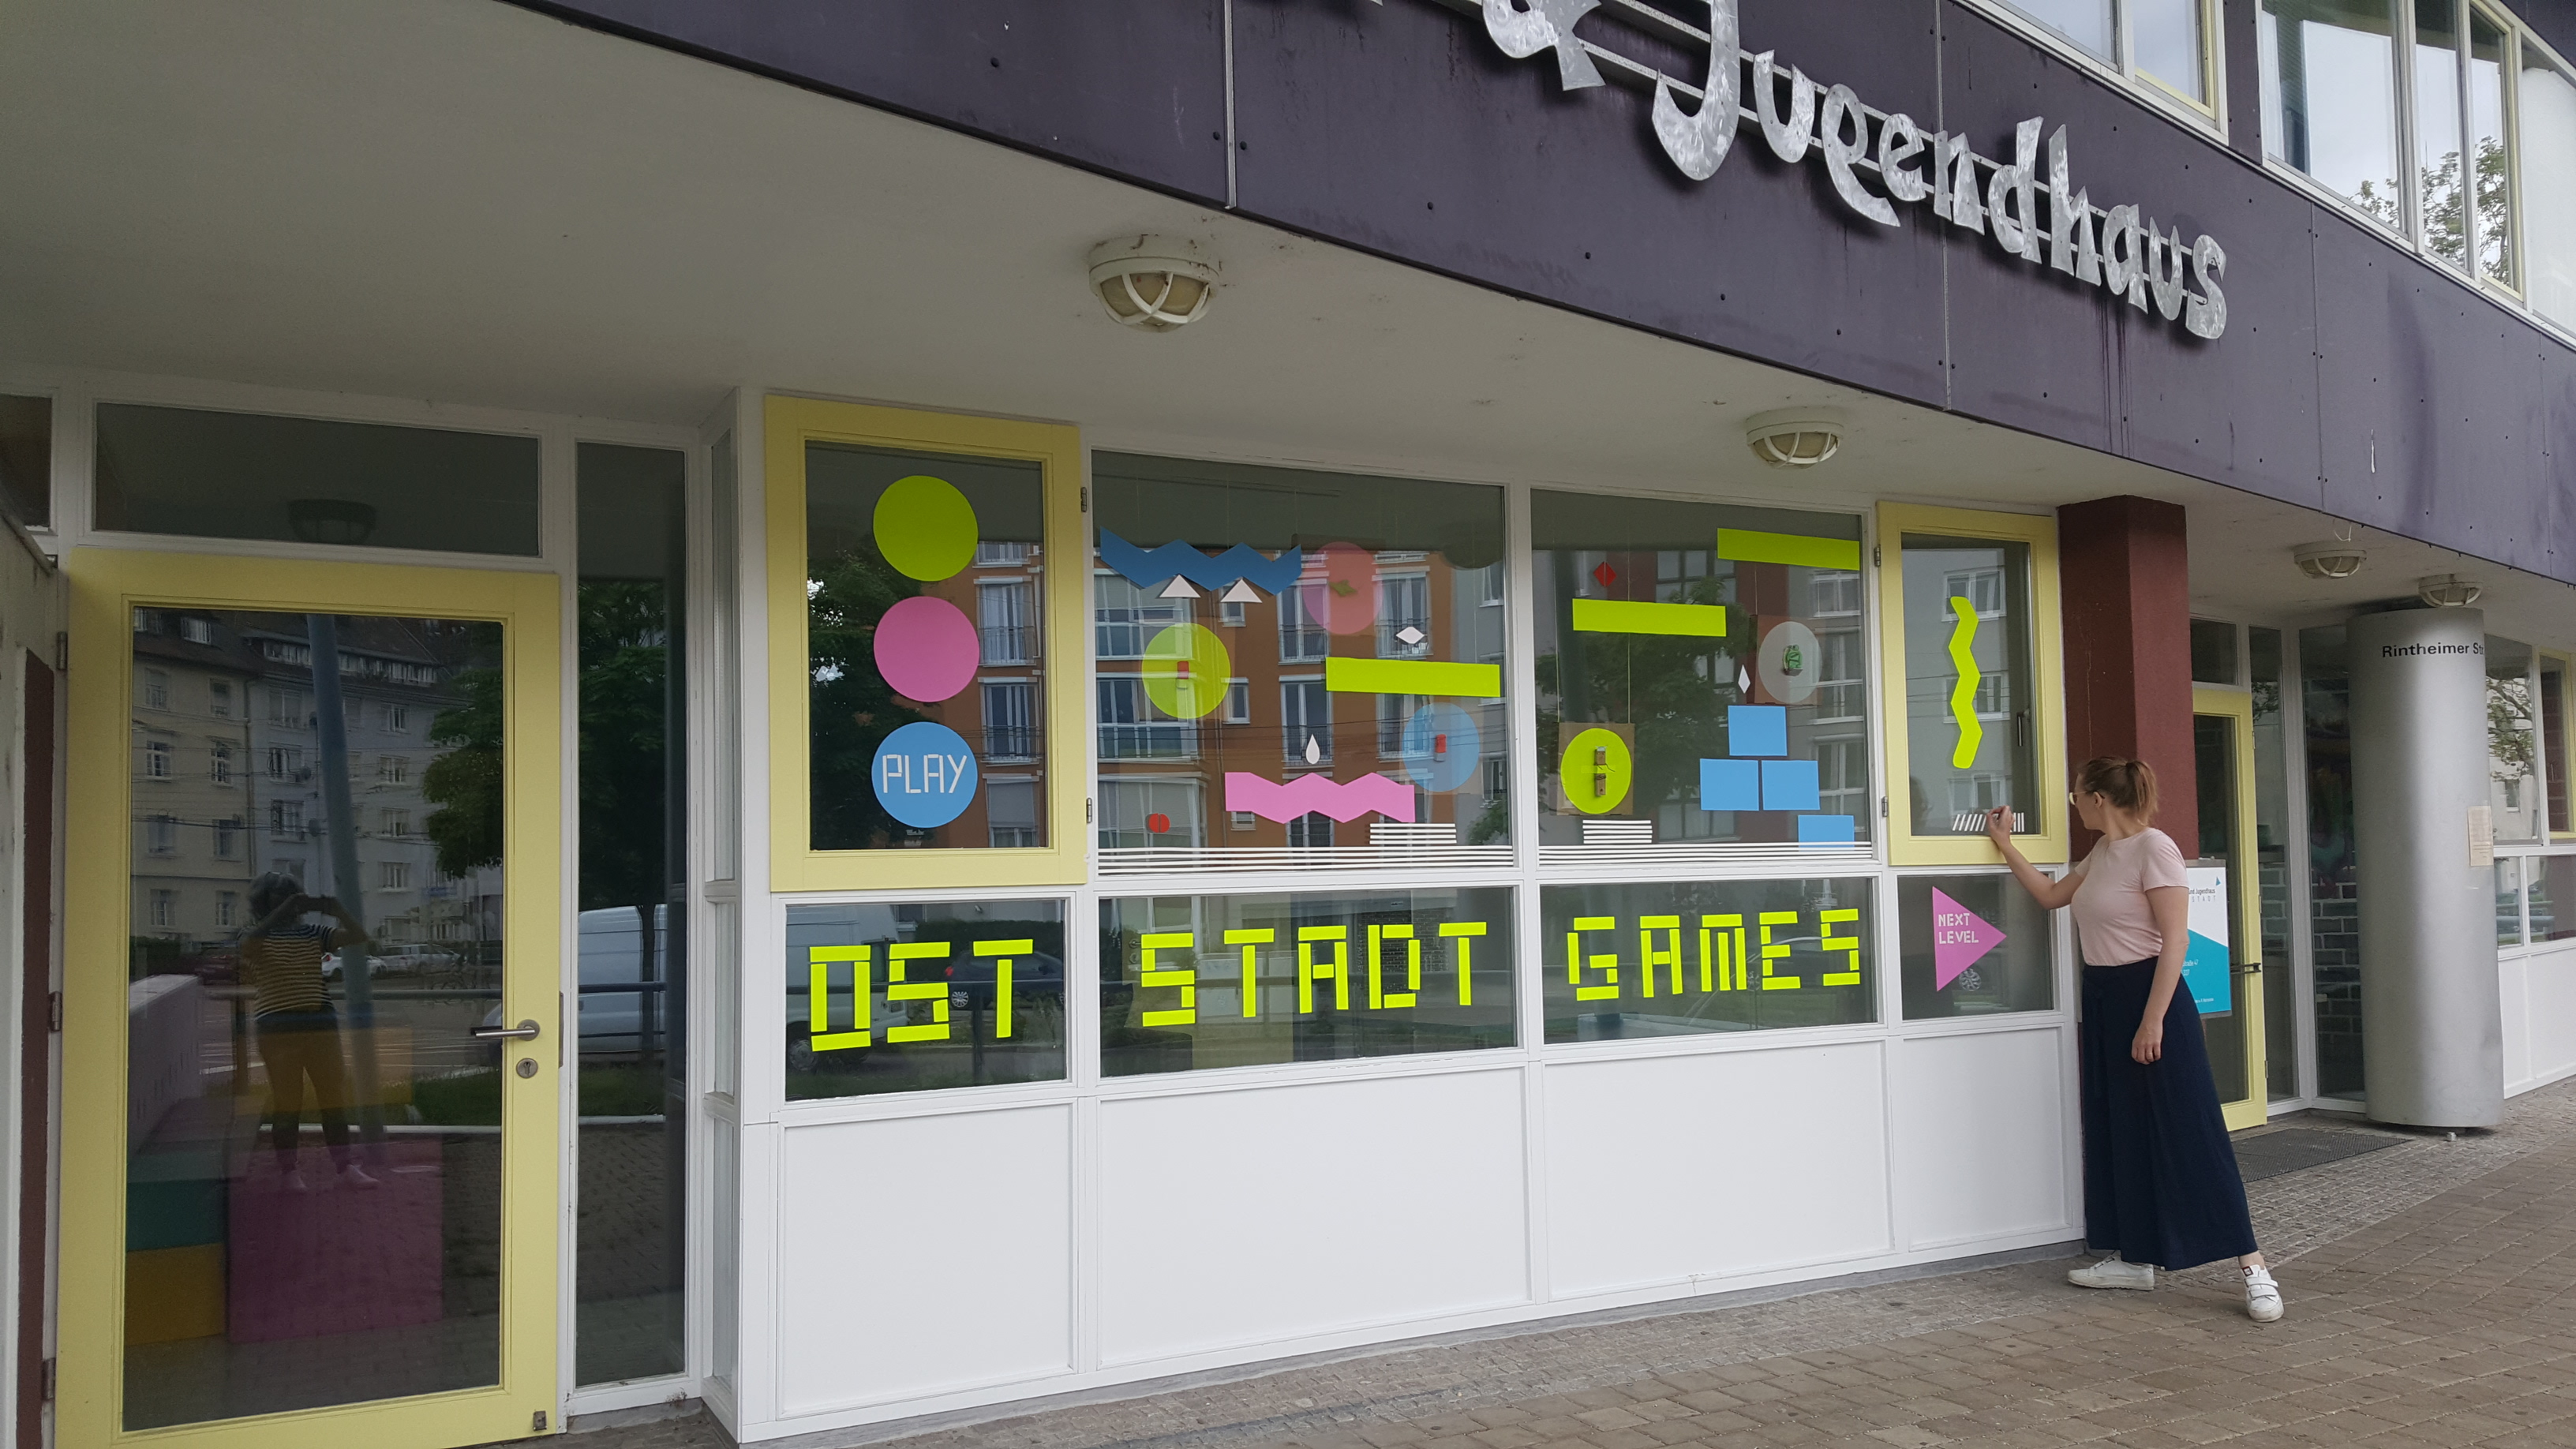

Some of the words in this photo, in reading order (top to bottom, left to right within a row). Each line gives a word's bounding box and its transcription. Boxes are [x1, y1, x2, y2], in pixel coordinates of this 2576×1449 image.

[1652, 0, 2228, 339] Jugendhaus
[2382, 642, 2469, 657] Rintheimer
[882, 754, 967, 794] PLAY
[1938, 912, 1970, 927] NEXT
[1938, 930, 1979, 945] LEVEL
[810, 938, 1033, 1052] OST
[1141, 921, 1487, 1028] STADT
[1567, 908, 1860, 1001] GAMES
